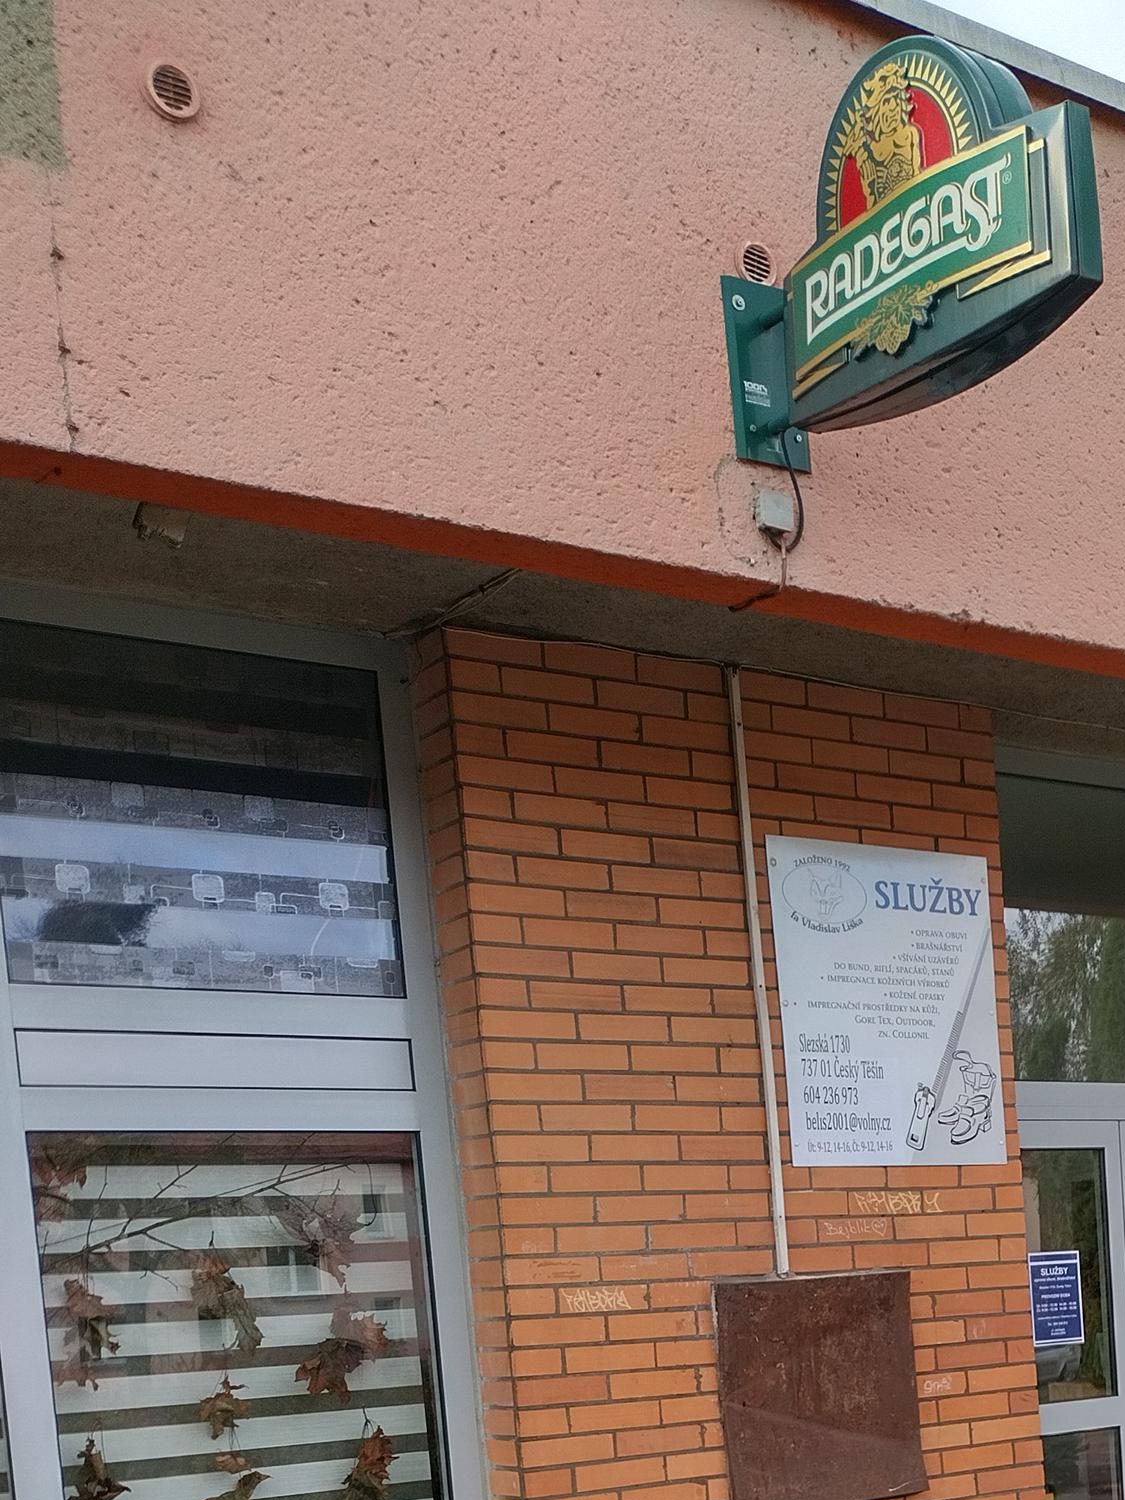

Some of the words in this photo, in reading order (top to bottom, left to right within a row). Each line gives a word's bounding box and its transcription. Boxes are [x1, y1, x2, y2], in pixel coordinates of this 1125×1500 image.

[806, 152, 1012, 338] RADEGAST
[793, 854, 833, 867] ZALOŽENO
[834, 859, 851, 872] 1992
[874, 877, 982, 917] SLUŽBY
[802, 917, 841, 934] Vladislav
[841, 918, 864, 932] Liška
[915, 929, 944, 939] OPRAVA
[945, 931, 968, 940] OBUVI
[915, 942, 963, 953] BRAŠNÁŘSTVÍ
[897, 953, 927, 964] VŠÍVÁNÍ
[834, 962, 847, 970] DO
[848, 963, 872, 973] BUND,
[896, 965, 930, 976] SPACÁKŮ,
[931, 967, 955, 977] STANŮ
[827, 974, 876, 985] IMPREGNACE
[877, 976, 916, 987] KOŽENÝCH
[917, 978, 950, 989] VÝROBKŮ
[918, 993, 945, 1001] OPASKY
[807, 1000, 861, 1011] IMPREGNAČNÍ
[862, 1001, 908, 1012] PROSTŘEDKY
[909, 1005, 920, 1013] NA
[799, 1033, 829, 1053] Slezská
[830, 1034, 851, 1054] 1730
[801, 1058, 818, 1077] 737
[820, 1059, 832, 1078] 01
[834, 1055, 860, 1083] Český
[861, 1060, 884, 1080] Těšín
[803, 1085, 821, 1104] 604
[822, 1086, 840, 1105] 236
[841, 1087, 859, 1105] 973
[805, 1111, 892, 1136] belis2001@volny.cz
[1040, 1266, 1069, 1277] SLUŽBY
